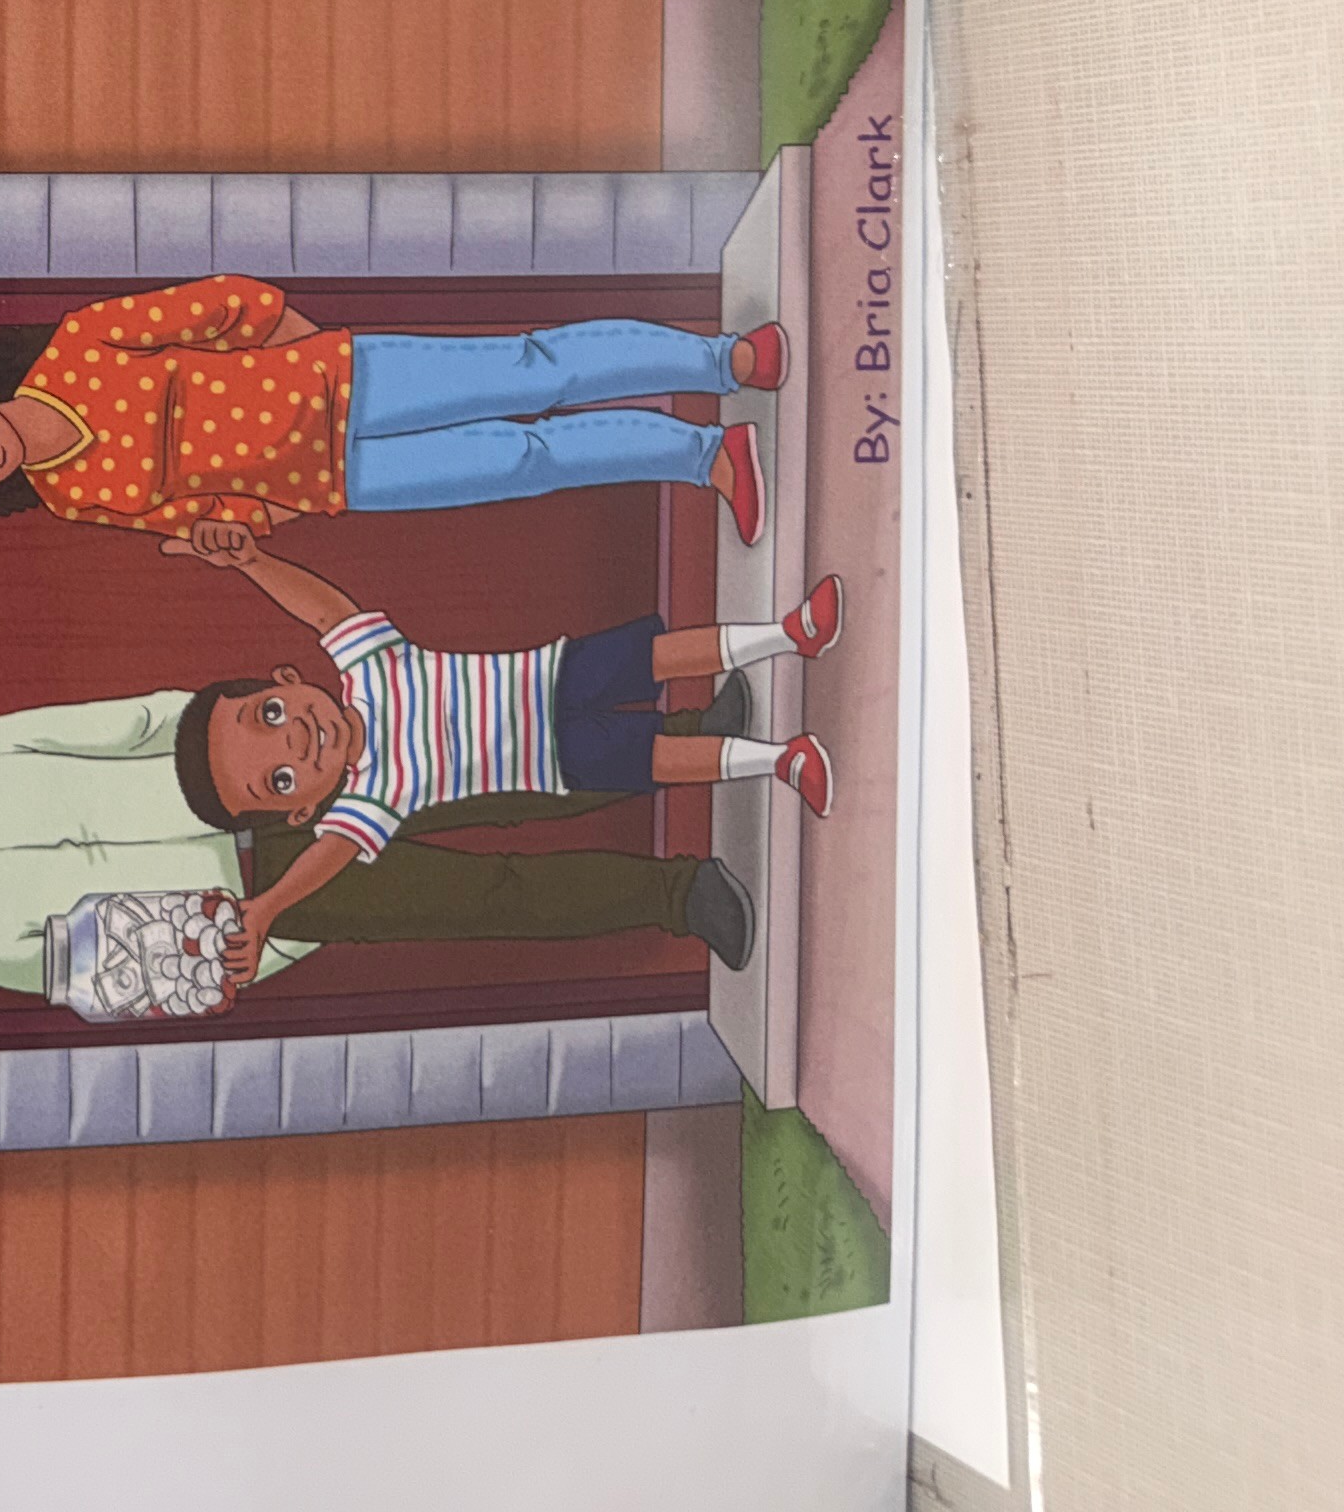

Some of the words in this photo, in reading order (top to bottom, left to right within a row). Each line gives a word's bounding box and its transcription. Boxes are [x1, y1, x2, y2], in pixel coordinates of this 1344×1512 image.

[856, 114, 893, 251] Clark
[855, 268, 892, 372] Bria
[853, 392, 901, 464] By:
